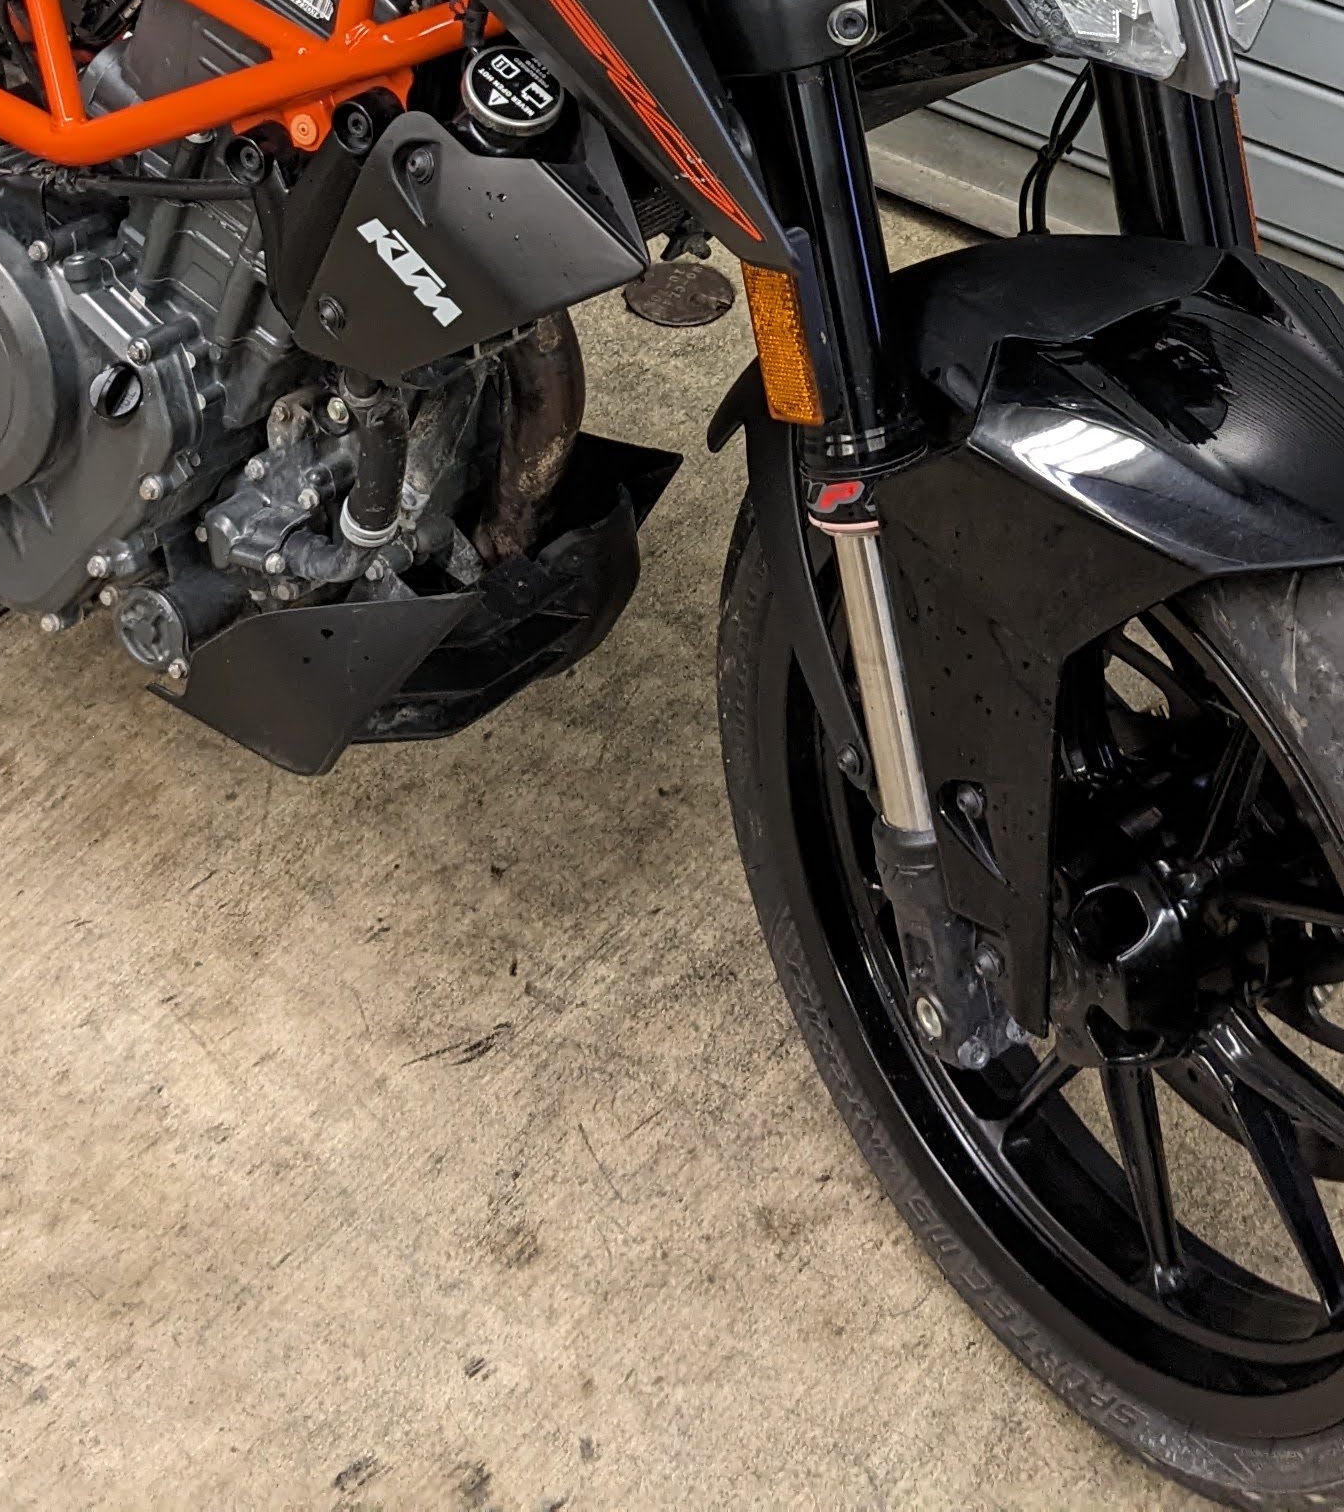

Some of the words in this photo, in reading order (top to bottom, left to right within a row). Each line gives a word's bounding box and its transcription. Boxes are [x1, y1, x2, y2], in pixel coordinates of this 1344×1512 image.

[478, 68, 494, 82] HOT
[492, 80, 513, 97] OPEN
[511, 95, 535, 117] NEVER
[357, 218, 462, 327] KTM
